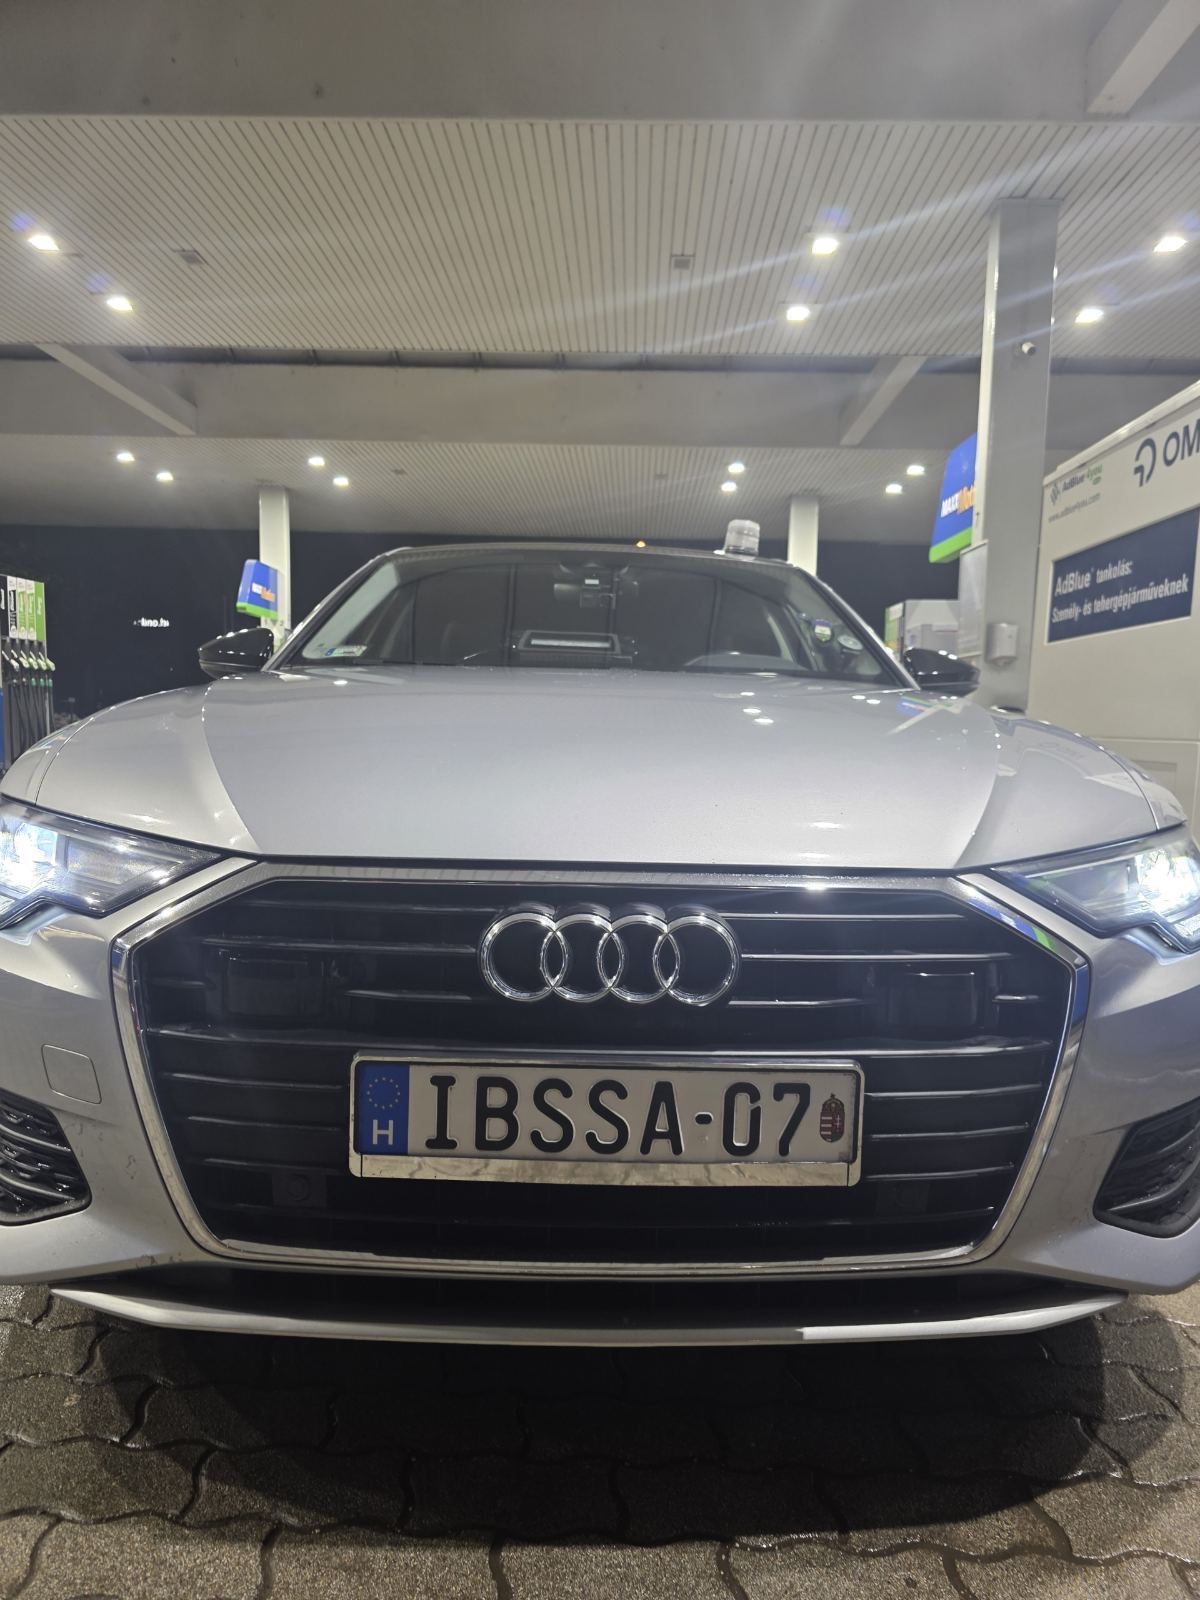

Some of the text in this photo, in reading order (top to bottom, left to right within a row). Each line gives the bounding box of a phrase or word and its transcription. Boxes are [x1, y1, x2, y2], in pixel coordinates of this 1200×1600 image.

[1163, 418, 1200, 467] OM
[372, 1119, 395, 1146] H
[425, 1075, 811, 1157] IBSSA-07
